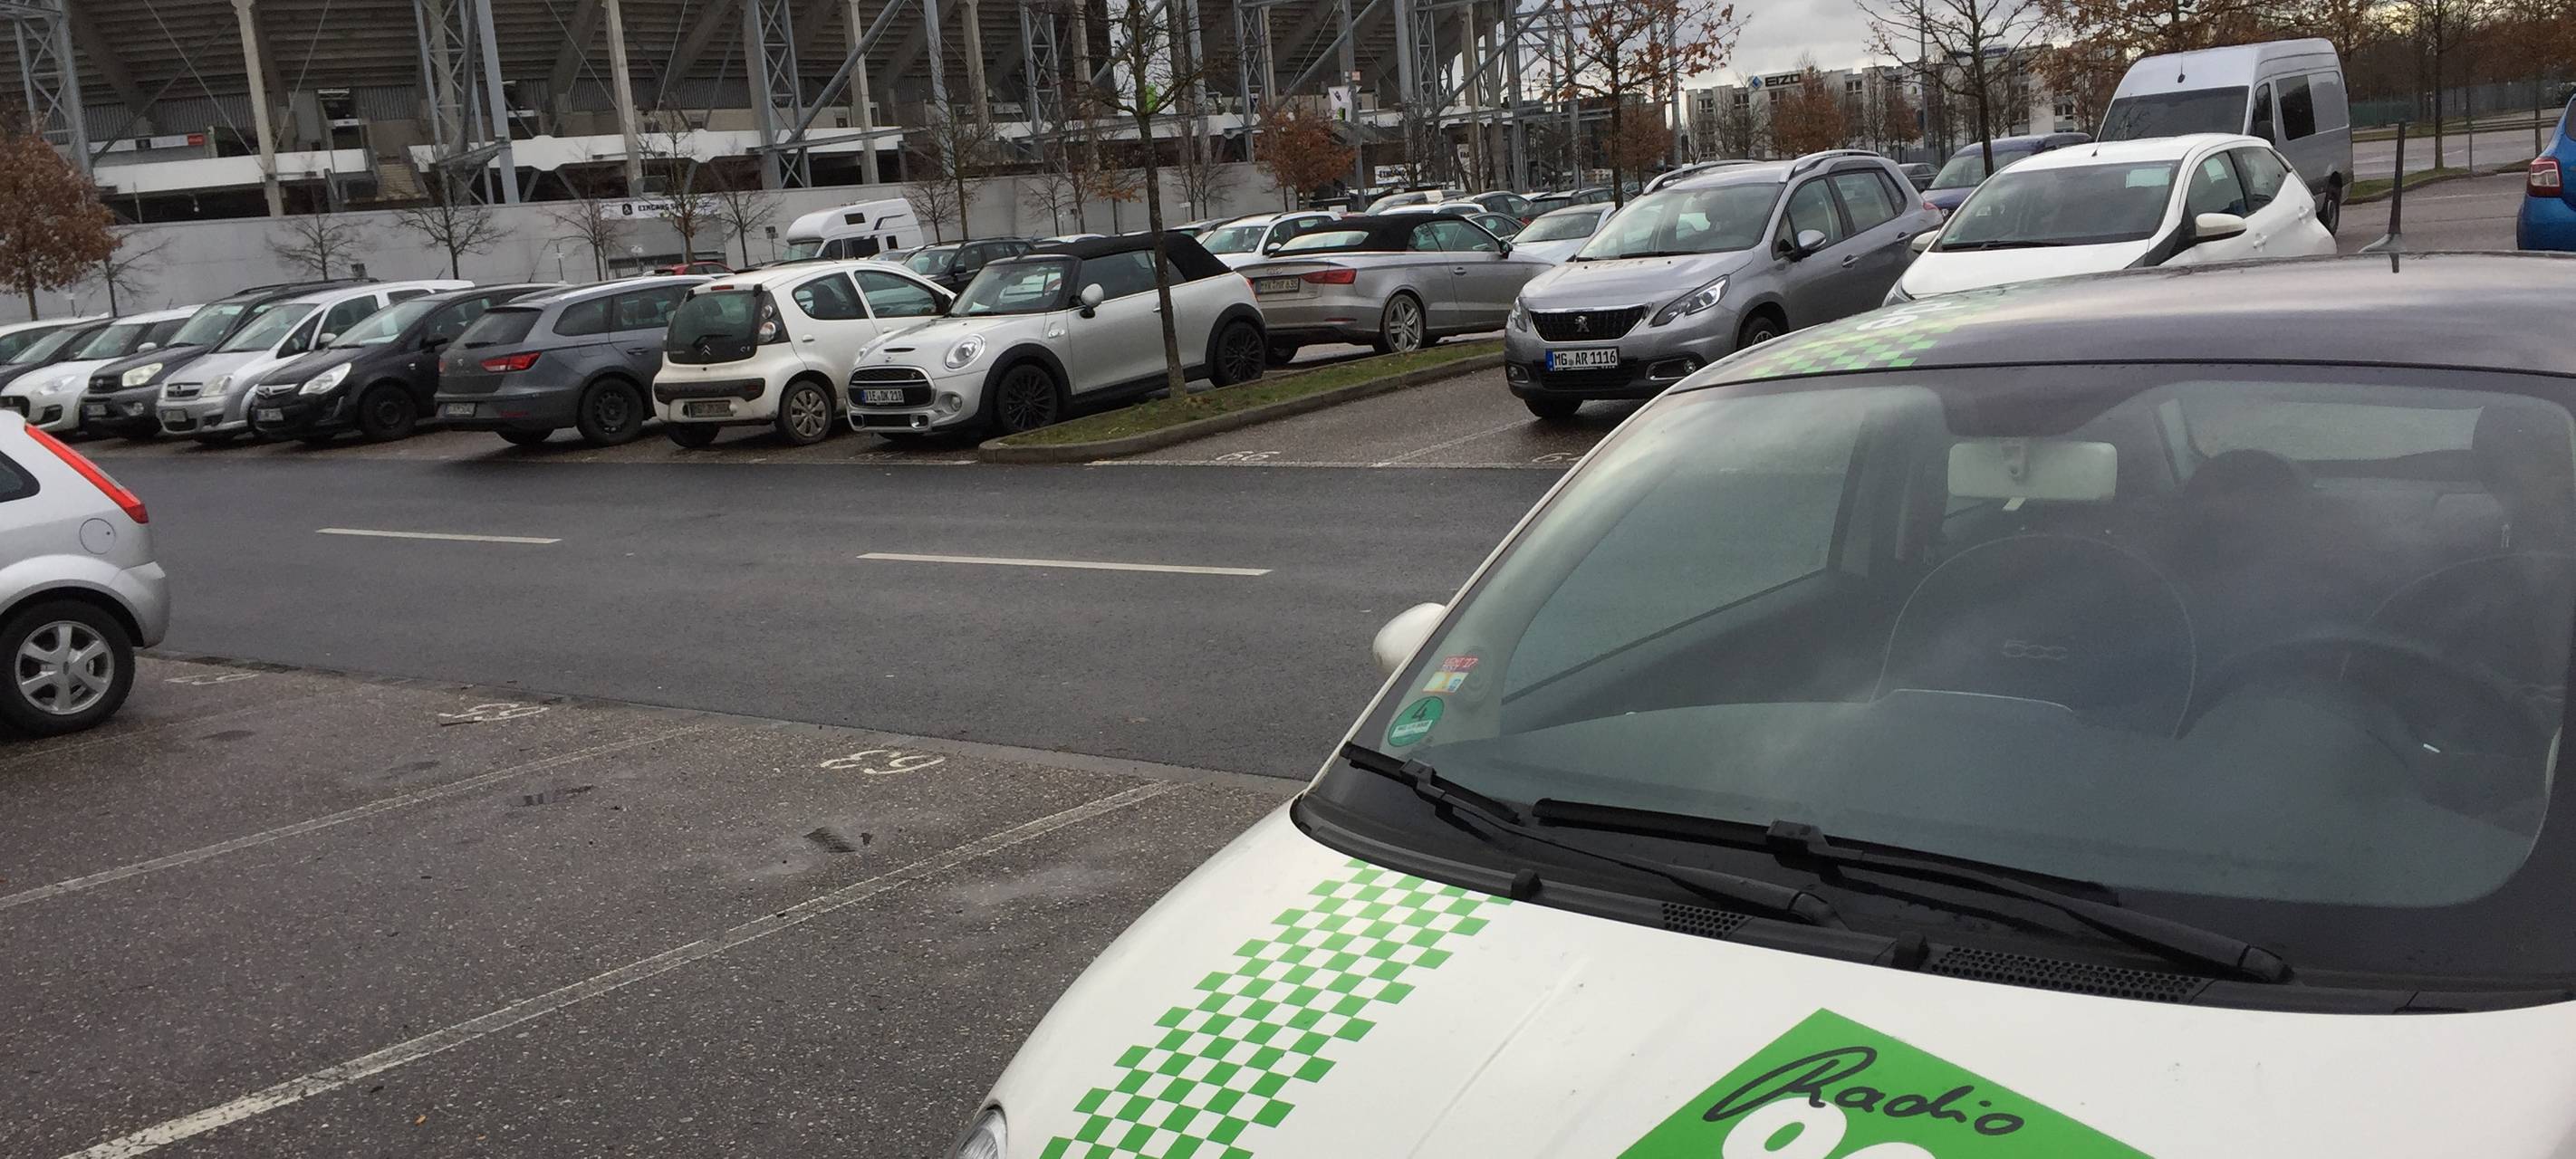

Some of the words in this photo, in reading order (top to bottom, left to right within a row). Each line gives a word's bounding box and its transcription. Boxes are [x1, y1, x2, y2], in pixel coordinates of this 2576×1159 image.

[1765, 73, 1801, 87] EIZO
[1554, 353, 1568, 366] MG
[1575, 352, 1589, 365] AR
[1590, 350, 1616, 364] 1116
[1411, 699, 1430, 721] 4
[1703, 1046, 2025, 1136] Radio
